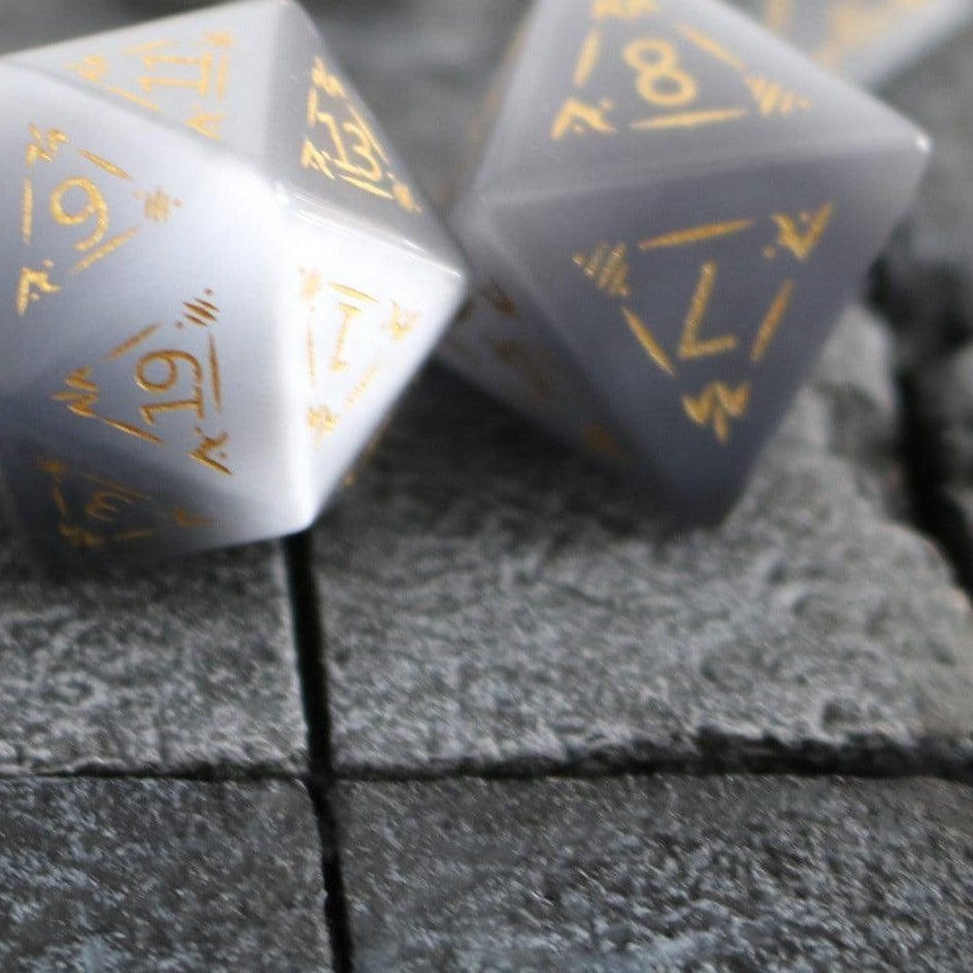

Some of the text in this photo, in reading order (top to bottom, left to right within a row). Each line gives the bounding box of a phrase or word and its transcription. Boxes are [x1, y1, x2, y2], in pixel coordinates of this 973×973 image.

[136, 52, 214, 97] 11
[624, 38, 698, 108] 8
[314, 110, 383, 180] 13
[49, 175, 110, 252] 9
[330, 301, 363, 372] 1
[677, 260, 739, 360] 7
[136, 348, 209, 427] 19
